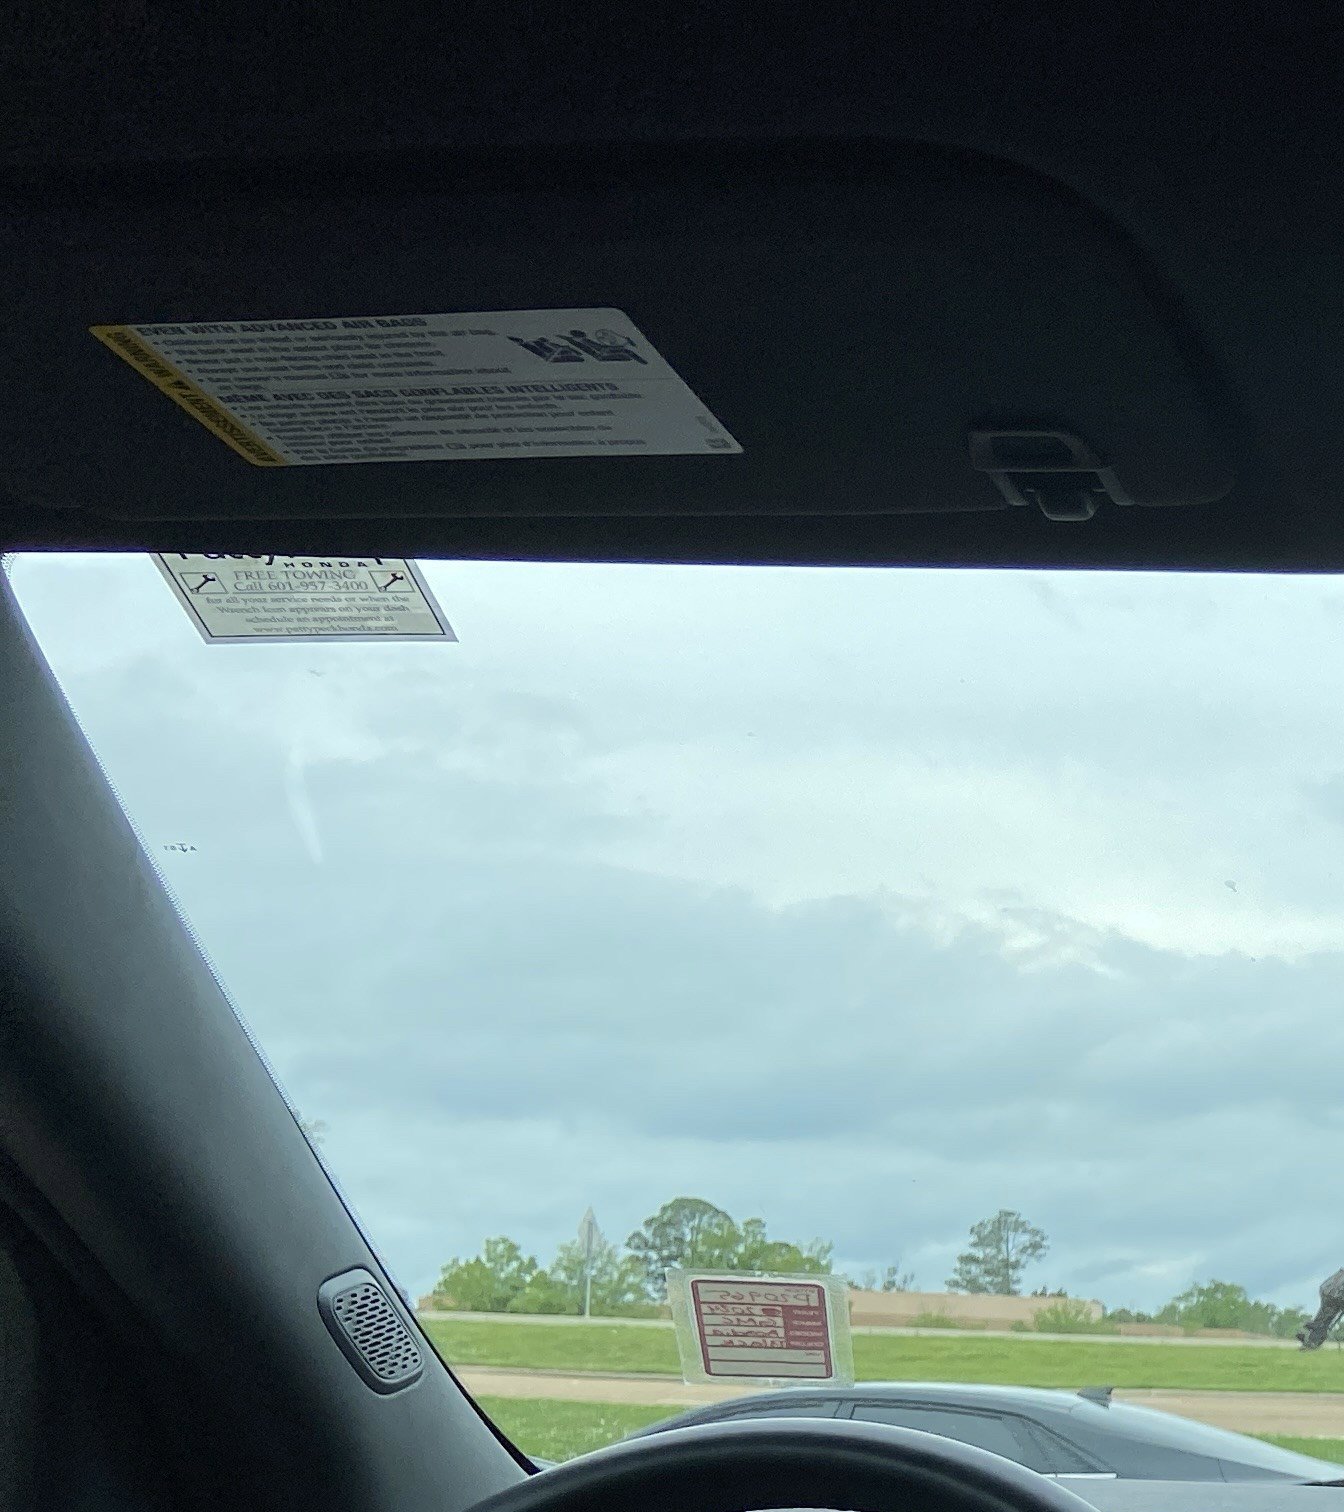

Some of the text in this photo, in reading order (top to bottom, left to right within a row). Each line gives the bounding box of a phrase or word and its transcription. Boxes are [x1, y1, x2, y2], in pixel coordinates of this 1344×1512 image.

[137, 326, 187, 336] EVEN
[187, 324, 235, 334] WITH
[239, 320, 338, 333] ADVANCED
[342, 319, 375, 330] AIR
[283, 561, 369, 569] HONDA
[232, 570, 357, 580] FREE TOWING
[233, 580, 263, 592] Call
